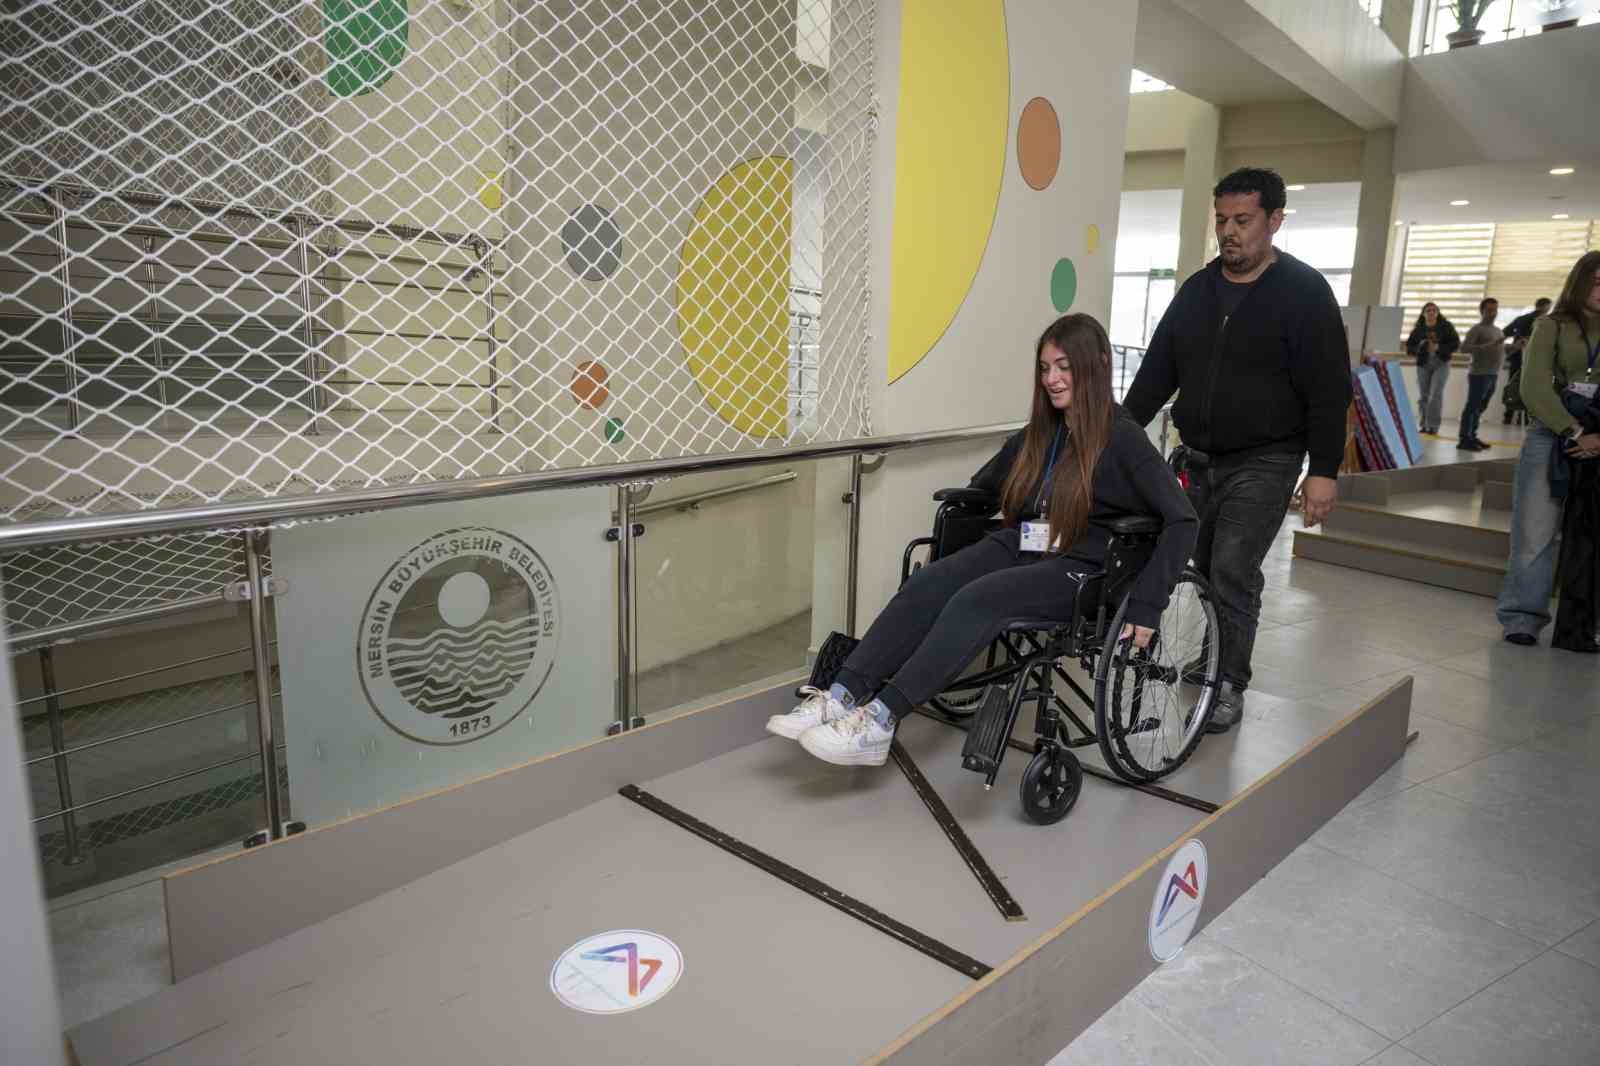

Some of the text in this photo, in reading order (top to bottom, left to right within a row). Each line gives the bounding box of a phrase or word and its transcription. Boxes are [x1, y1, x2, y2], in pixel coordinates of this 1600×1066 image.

[367, 600, 393, 679] MERSİN
[388, 536, 503, 594] BÜYÜKŞEHİR
[449, 715, 491, 737] 1873
